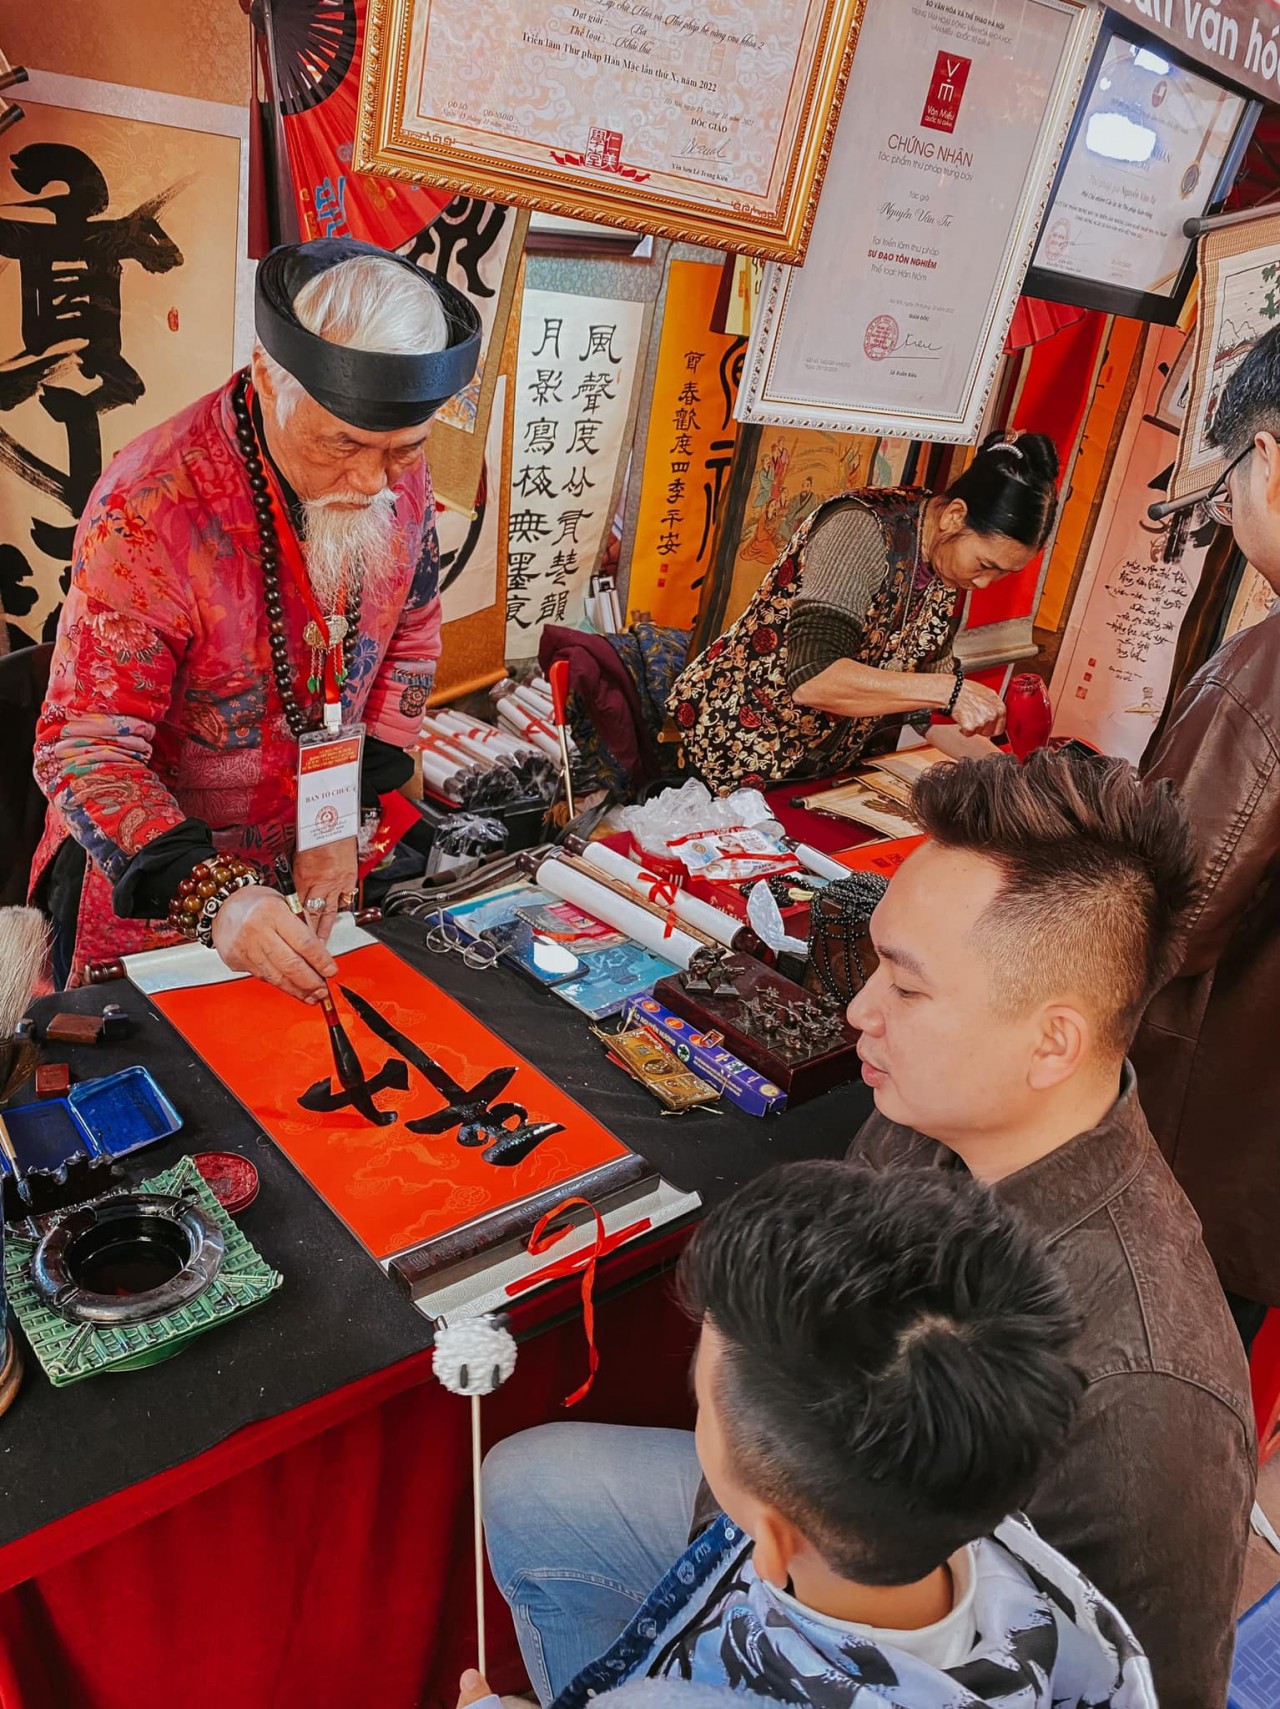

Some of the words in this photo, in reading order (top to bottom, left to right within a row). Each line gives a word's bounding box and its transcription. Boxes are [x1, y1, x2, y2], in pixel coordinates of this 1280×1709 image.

[1243, 17, 1280, 85] hó
[699, 80, 717, 92] 2022
[888, 134, 935, 158] CHỨNG
[937, 146, 973, 168] NHẬN
